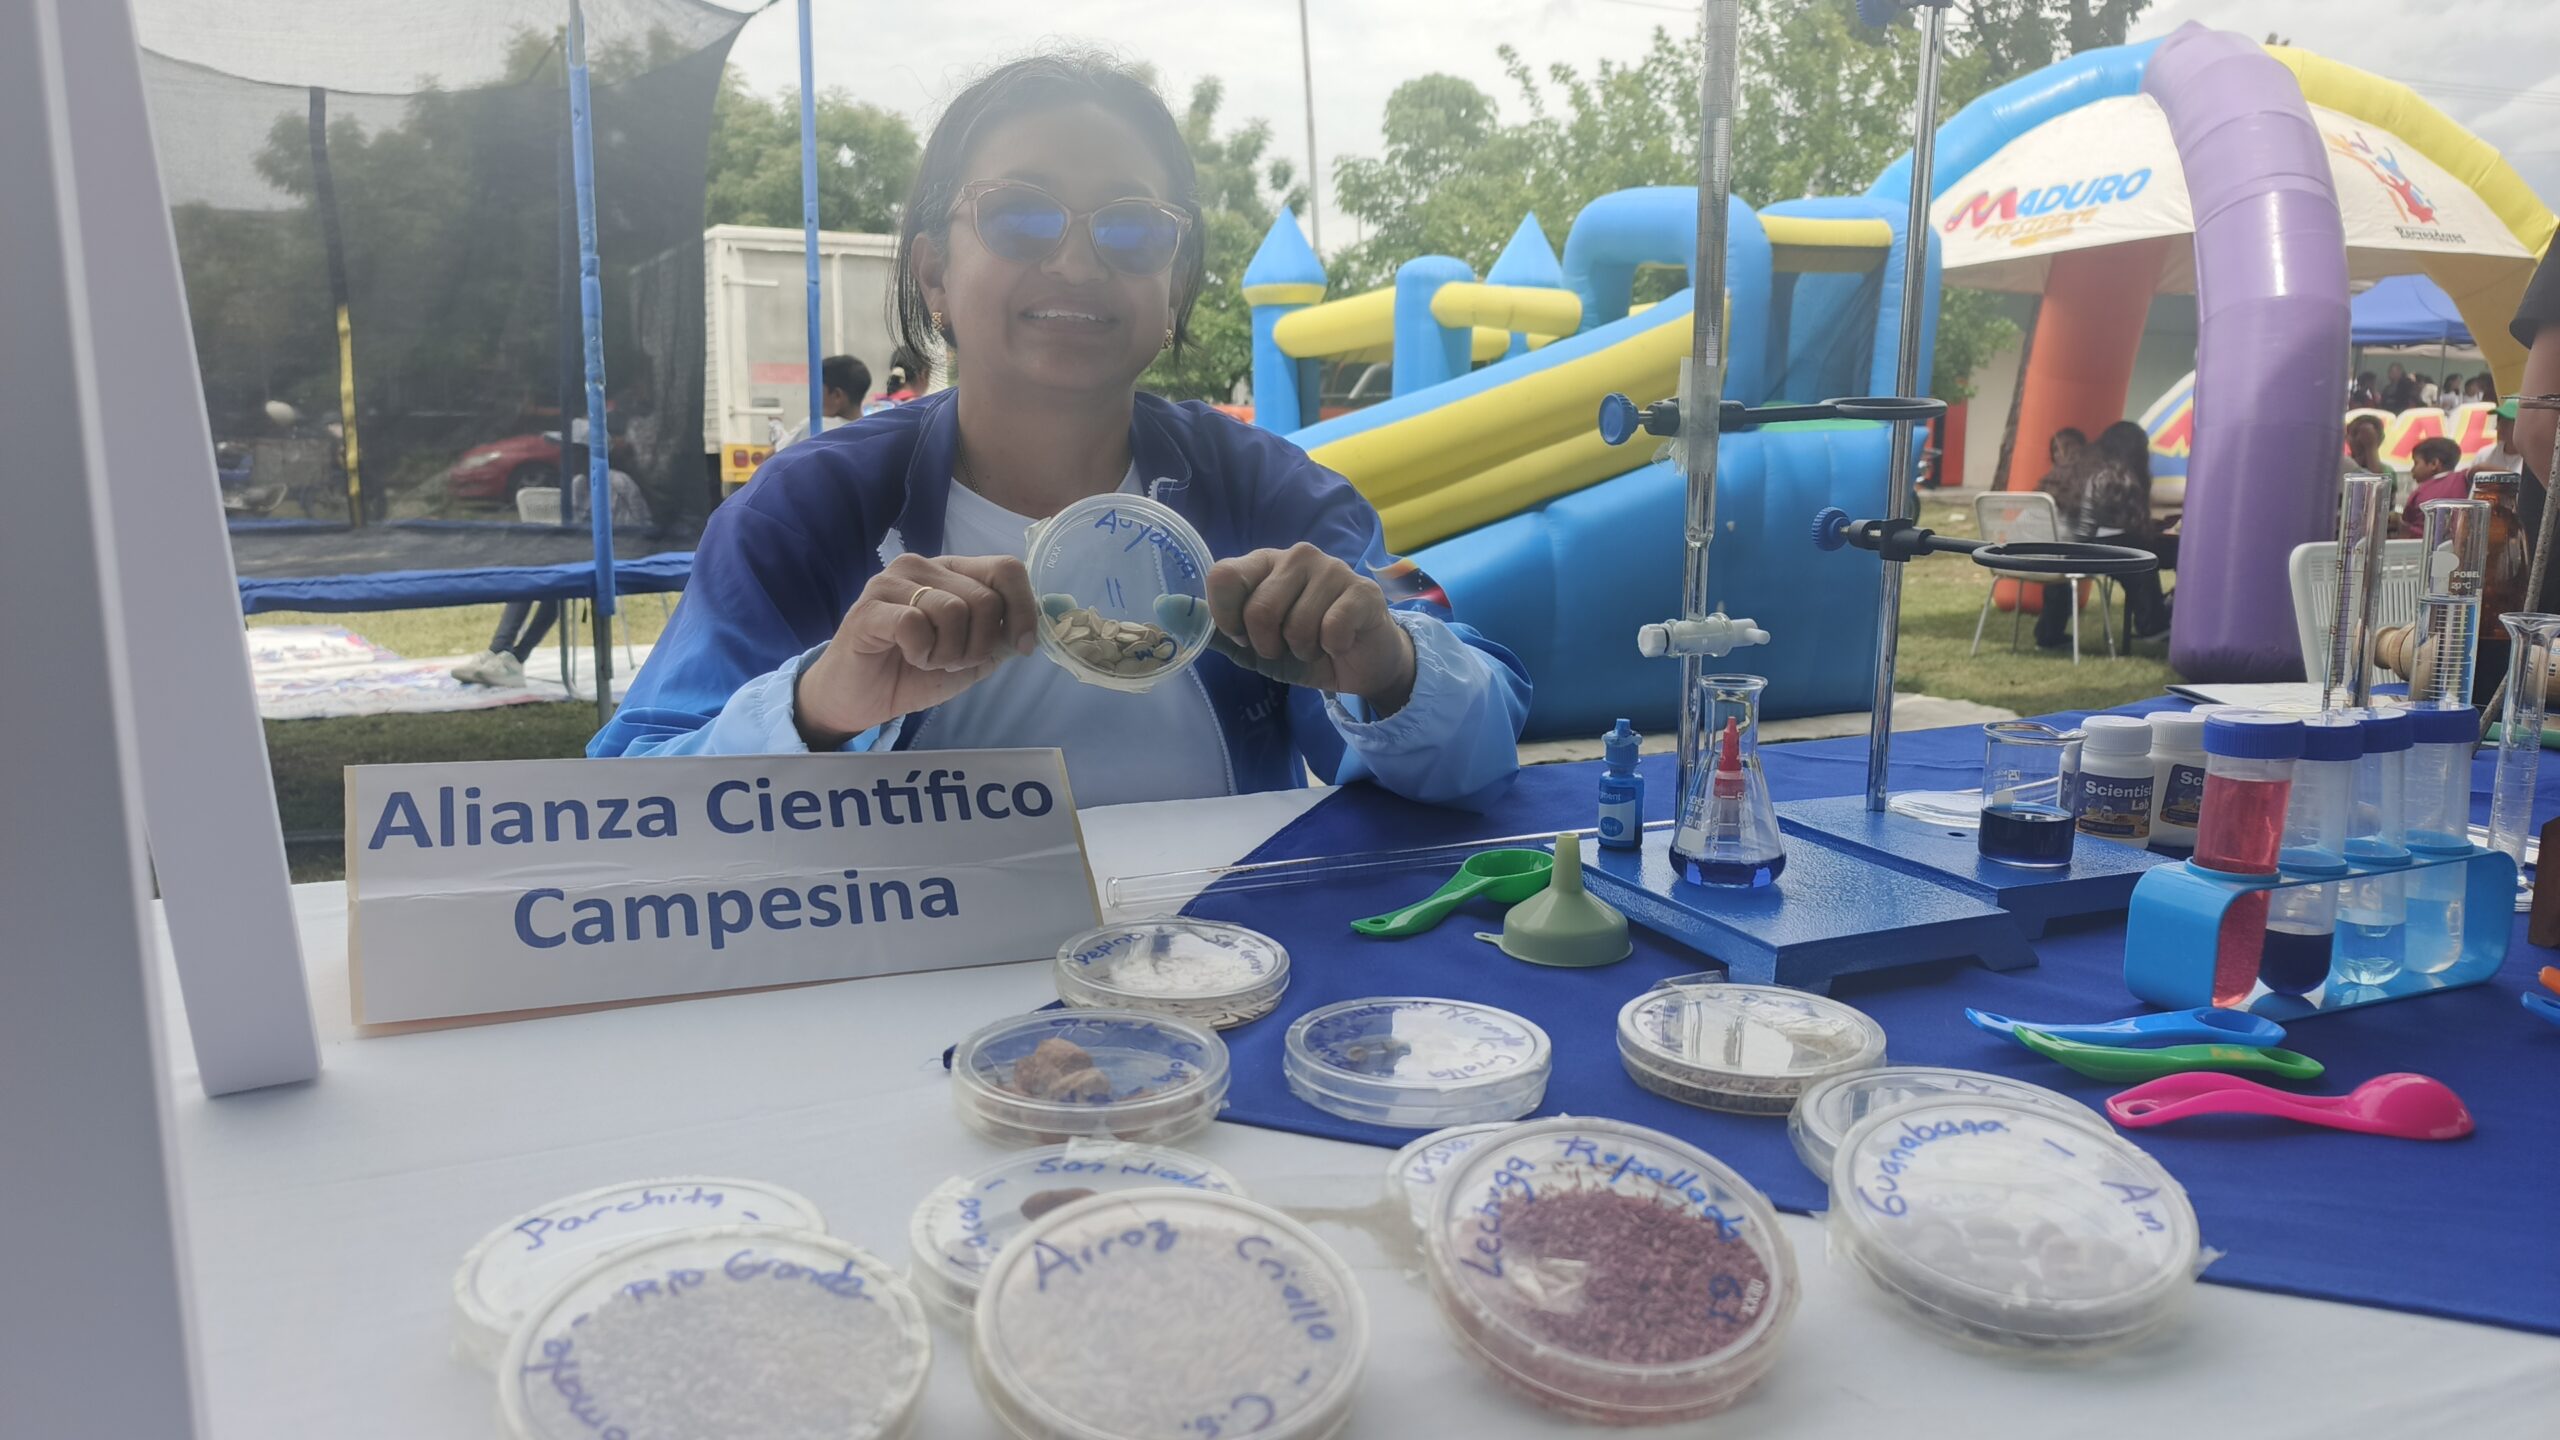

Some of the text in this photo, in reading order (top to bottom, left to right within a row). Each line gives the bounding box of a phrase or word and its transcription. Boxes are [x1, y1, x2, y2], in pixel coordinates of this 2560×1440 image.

[1944, 168, 2152, 233] MADURO
[368, 769, 1054, 850] Alianza Científico
[513, 868, 960, 950] Campesina
